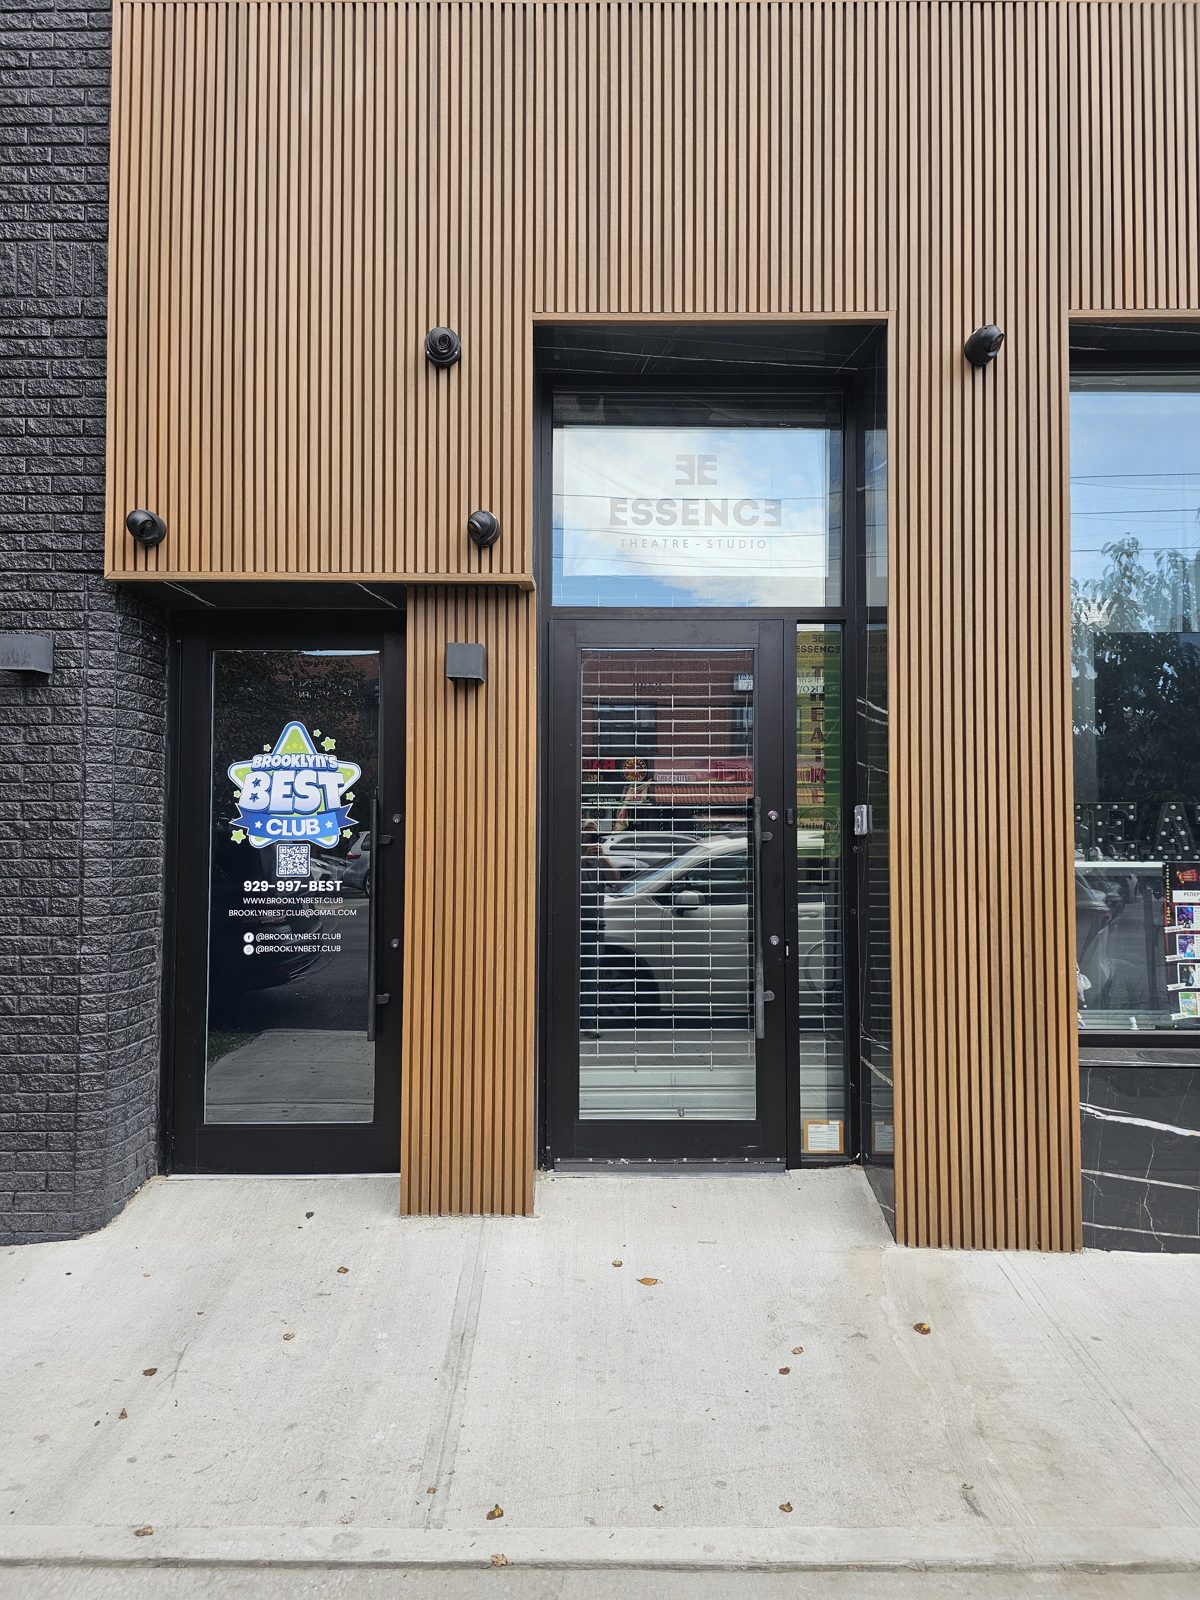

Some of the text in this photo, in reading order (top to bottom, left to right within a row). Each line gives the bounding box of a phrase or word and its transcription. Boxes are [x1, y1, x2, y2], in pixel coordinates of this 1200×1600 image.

[620, 538, 689, 549] THEATRE
[706, 538, 767, 549] STUDIO
[239, 769, 345, 815] BEST
[265, 818, 321, 836] CLUB
[243, 880, 343, 892] 929-997-BEST
[242, 896, 344, 905] WWW.BROOKLYNBEST.CLUB
[228, 908, 357, 918] BROOKLYNBEST.CLUB@GMAIL.COM
[255, 932, 341, 942] @BROOKLYNBEST.CLUB
[255, 944, 341, 954] @BROOKLYNBEST.CLUB
